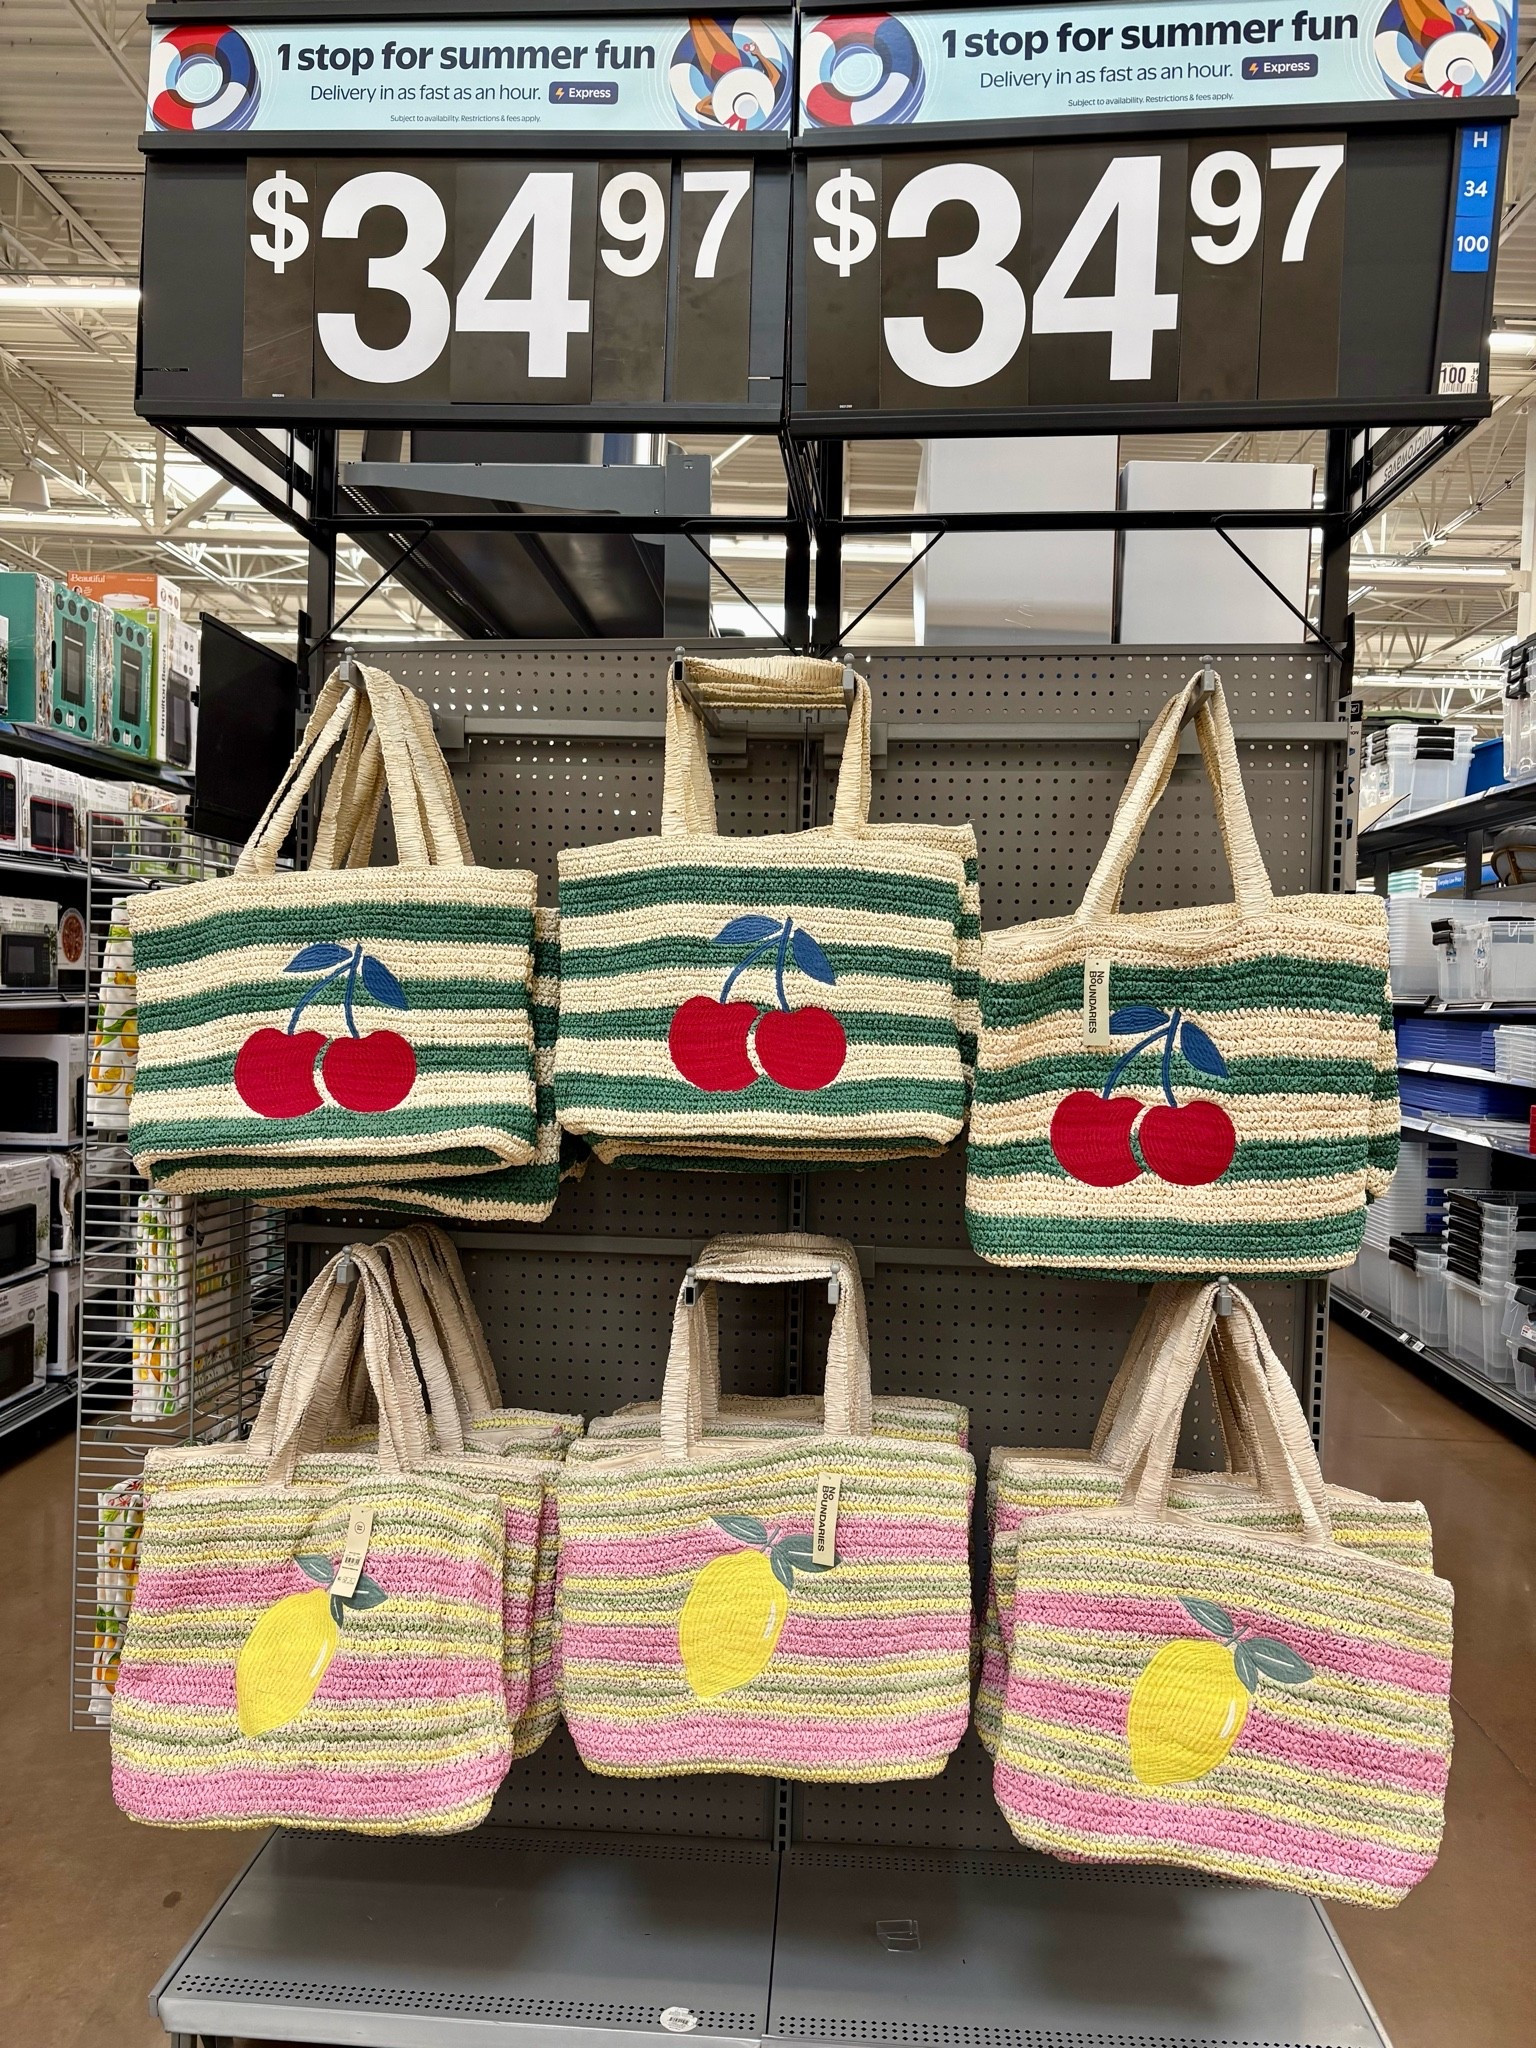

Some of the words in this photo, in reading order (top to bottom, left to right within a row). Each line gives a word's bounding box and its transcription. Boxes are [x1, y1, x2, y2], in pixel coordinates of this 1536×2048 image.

[942, 29, 956, 59] 1
[964, 28, 1049, 61] stop
[1057, 22, 1113, 53] for
[1121, 18, 1284, 50] summer
[1292, 10, 1358, 42] fun
[277, 43, 291, 71] 1
[297, 43, 374, 76] stop
[382, 41, 434, 70] for
[440, 45, 588, 70] summer
[595, 39, 655, 70] fun
[980, 70, 1052, 88] Delivery
[1056, 68, 1071, 84] in
[1076, 69, 1096, 84] as
[1099, 66, 1133, 83] fast
[1136, 66, 1157, 81] as
[1160, 65, 1183, 80] an
[1187, 62, 1233, 79] hour.
[1263, 61, 1310, 75] Express
[310, 84, 377, 103] Delivery
[380, 84, 394, 100] in
[397, 87, 415, 100] as
[419, 84, 450, 100] fast
[453, 87, 472, 100] as
[475, 87, 496, 100] an
[499, 83, 541, 100] hour.
[568, 87, 612, 100] Express
[1068, 97, 1096, 107] Subject
[1096, 97, 1104, 105] to
[1105, 95, 1144, 105] availability.
[1145, 94, 1188, 103] Restrictions
[1189, 93, 1195, 101] &
[1196, 93, 1211, 101] fees
[1212, 93, 1234, 103] apply.
[390, 114, 415, 123] Subject
[424, 114, 460, 123] availability.
[461, 114, 500, 122] Restrictions
[506, 114, 521, 122] fees
[521, 114, 541, 123] apply.
[1473, 131, 1488, 148] H
[1463, 180, 1488, 198] 34
[1456, 235, 1489, 253] 100
[1440, 367, 1466, 384] 100
[70, 573, 106, 583] Beautiful
[1097, 971, 1104, 984] NO
[1089, 971, 1097, 1033] BOUNDARIES
[829, 1487, 836, 1500] NO
[818, 1486, 829, 1551] BOUNDARIES
